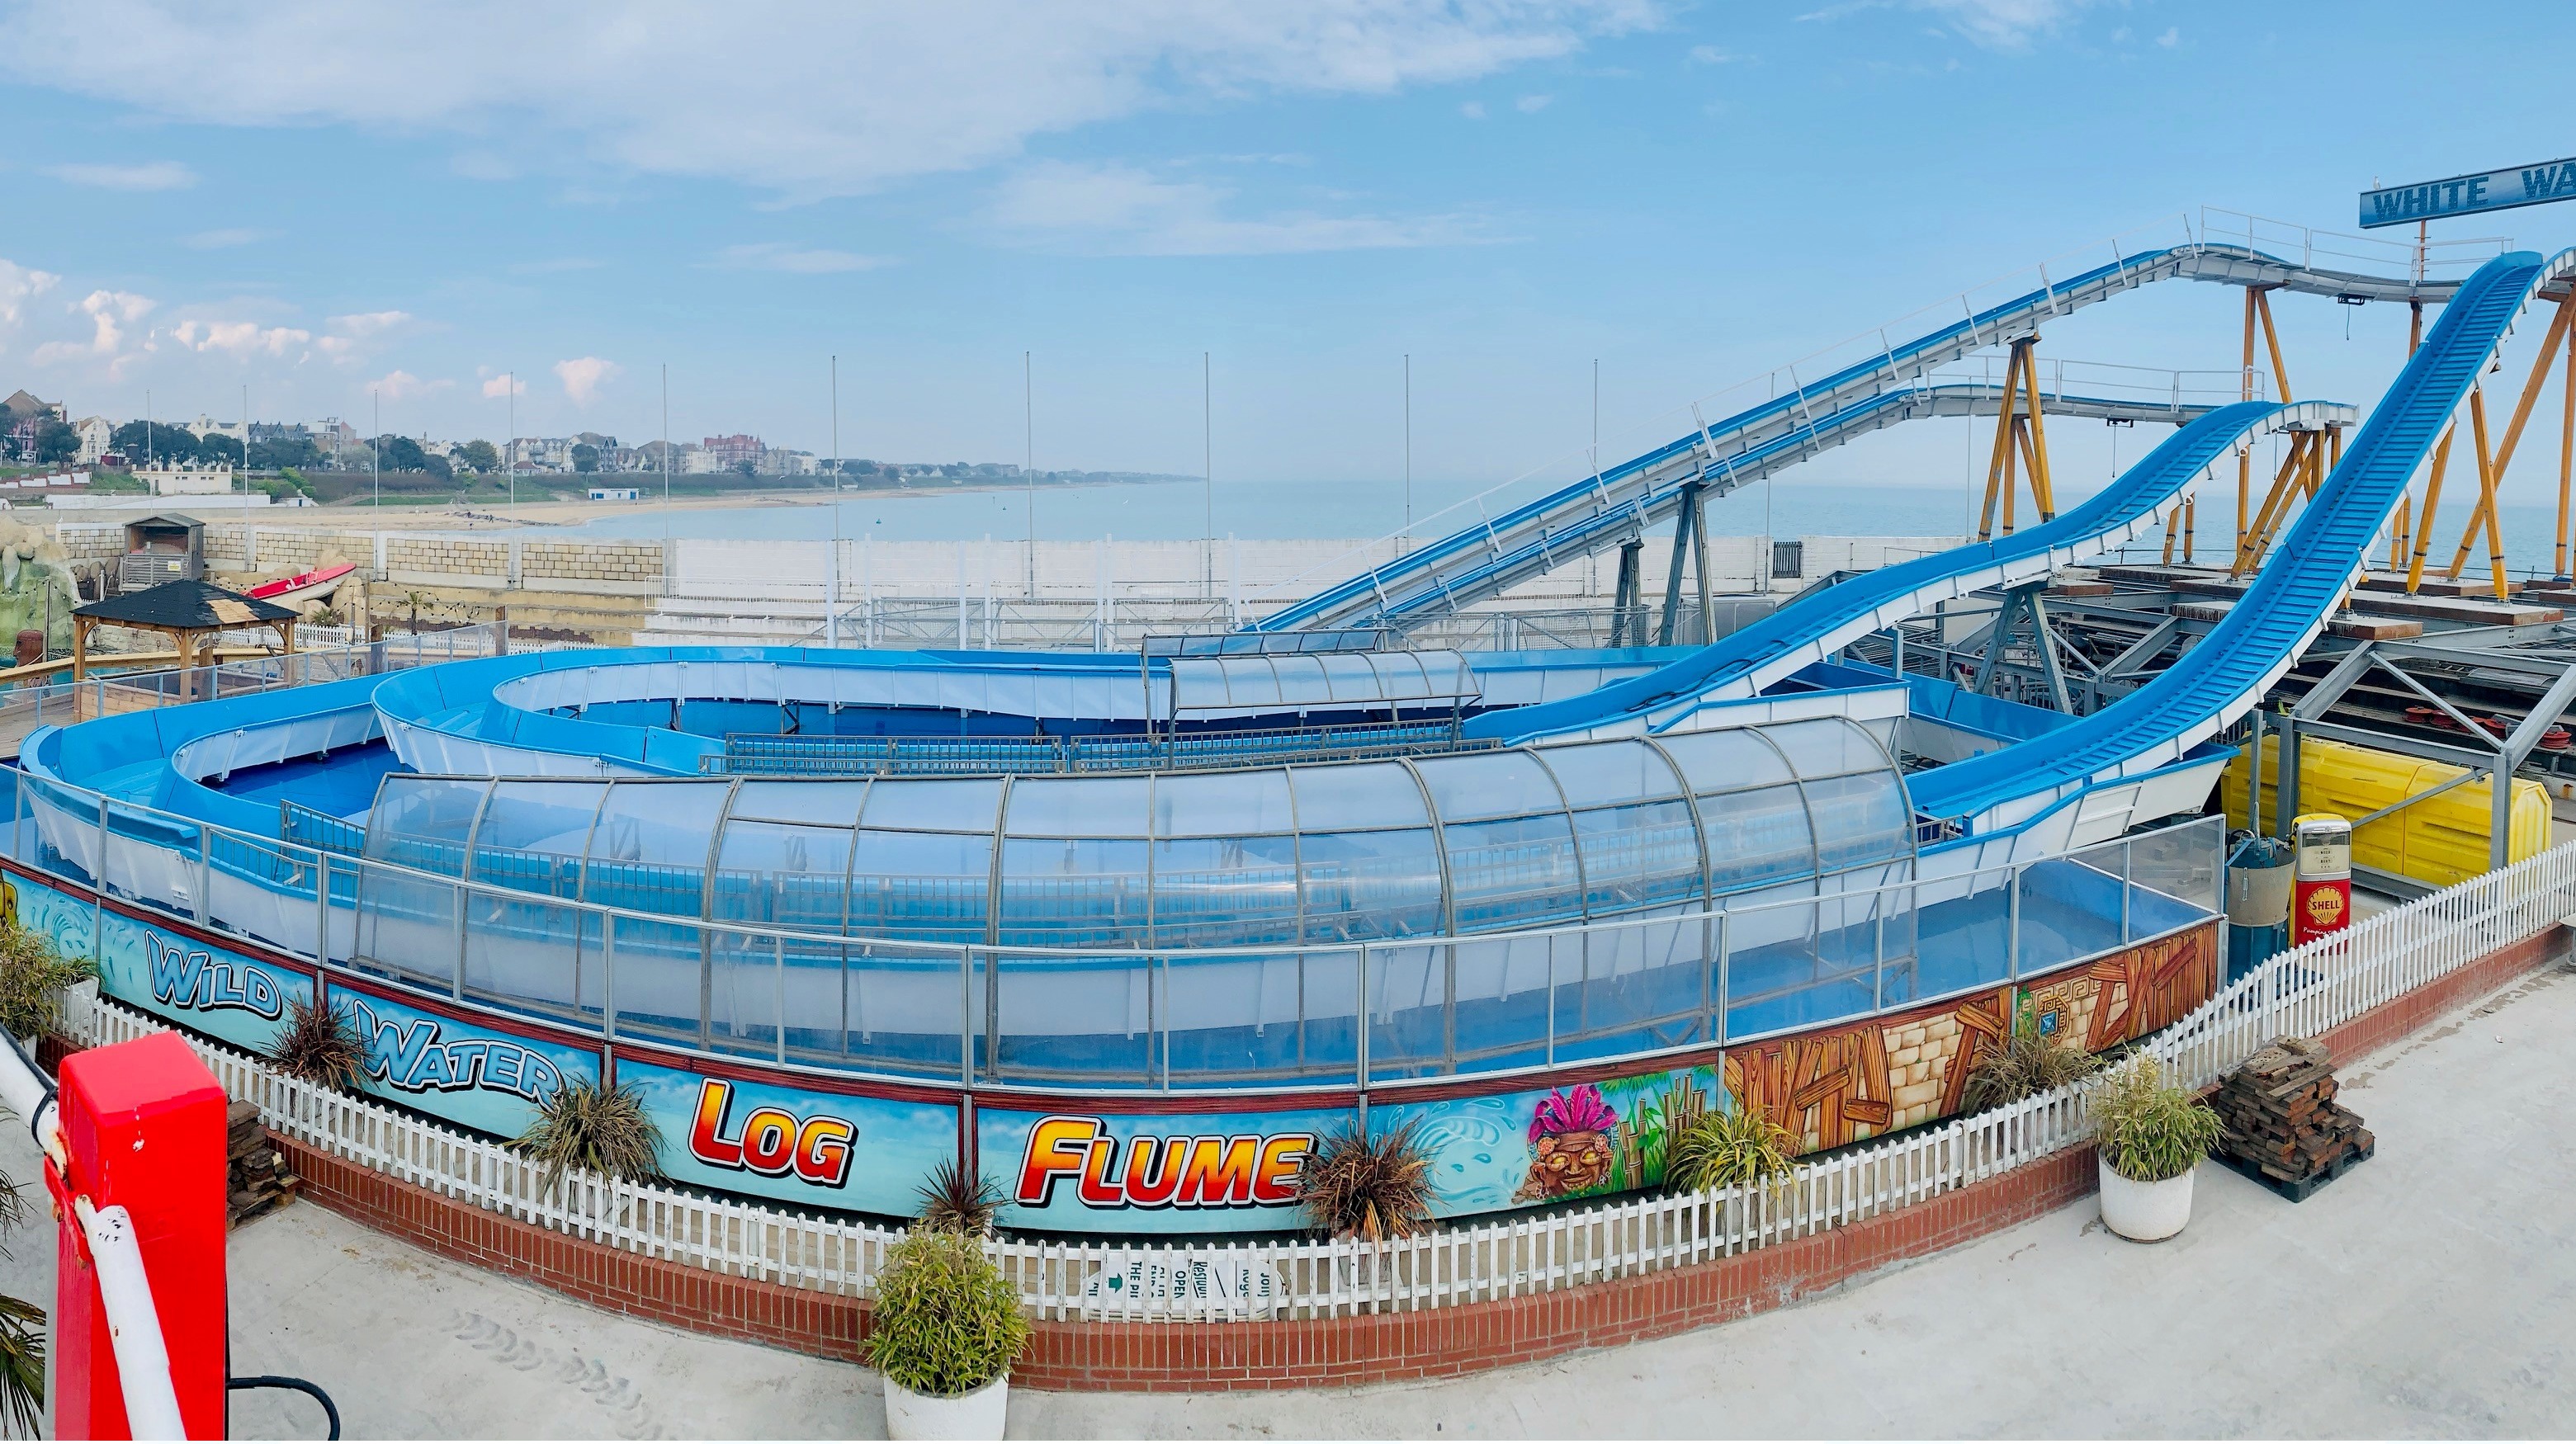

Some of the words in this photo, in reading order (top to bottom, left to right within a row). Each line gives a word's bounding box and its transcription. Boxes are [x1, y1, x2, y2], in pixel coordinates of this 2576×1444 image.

[2372, 176, 2489, 220] WHITE
[2521, 162, 2576, 198] WA
[2312, 900, 2340, 910] SHELL
[144, 929, 282, 1021] WILD
[353, 999, 569, 1114] WATER
[688, 1076, 858, 1188] LOG
[1014, 1115, 1318, 1209] FLUME
[1130, 1261, 1142, 1281] THE
